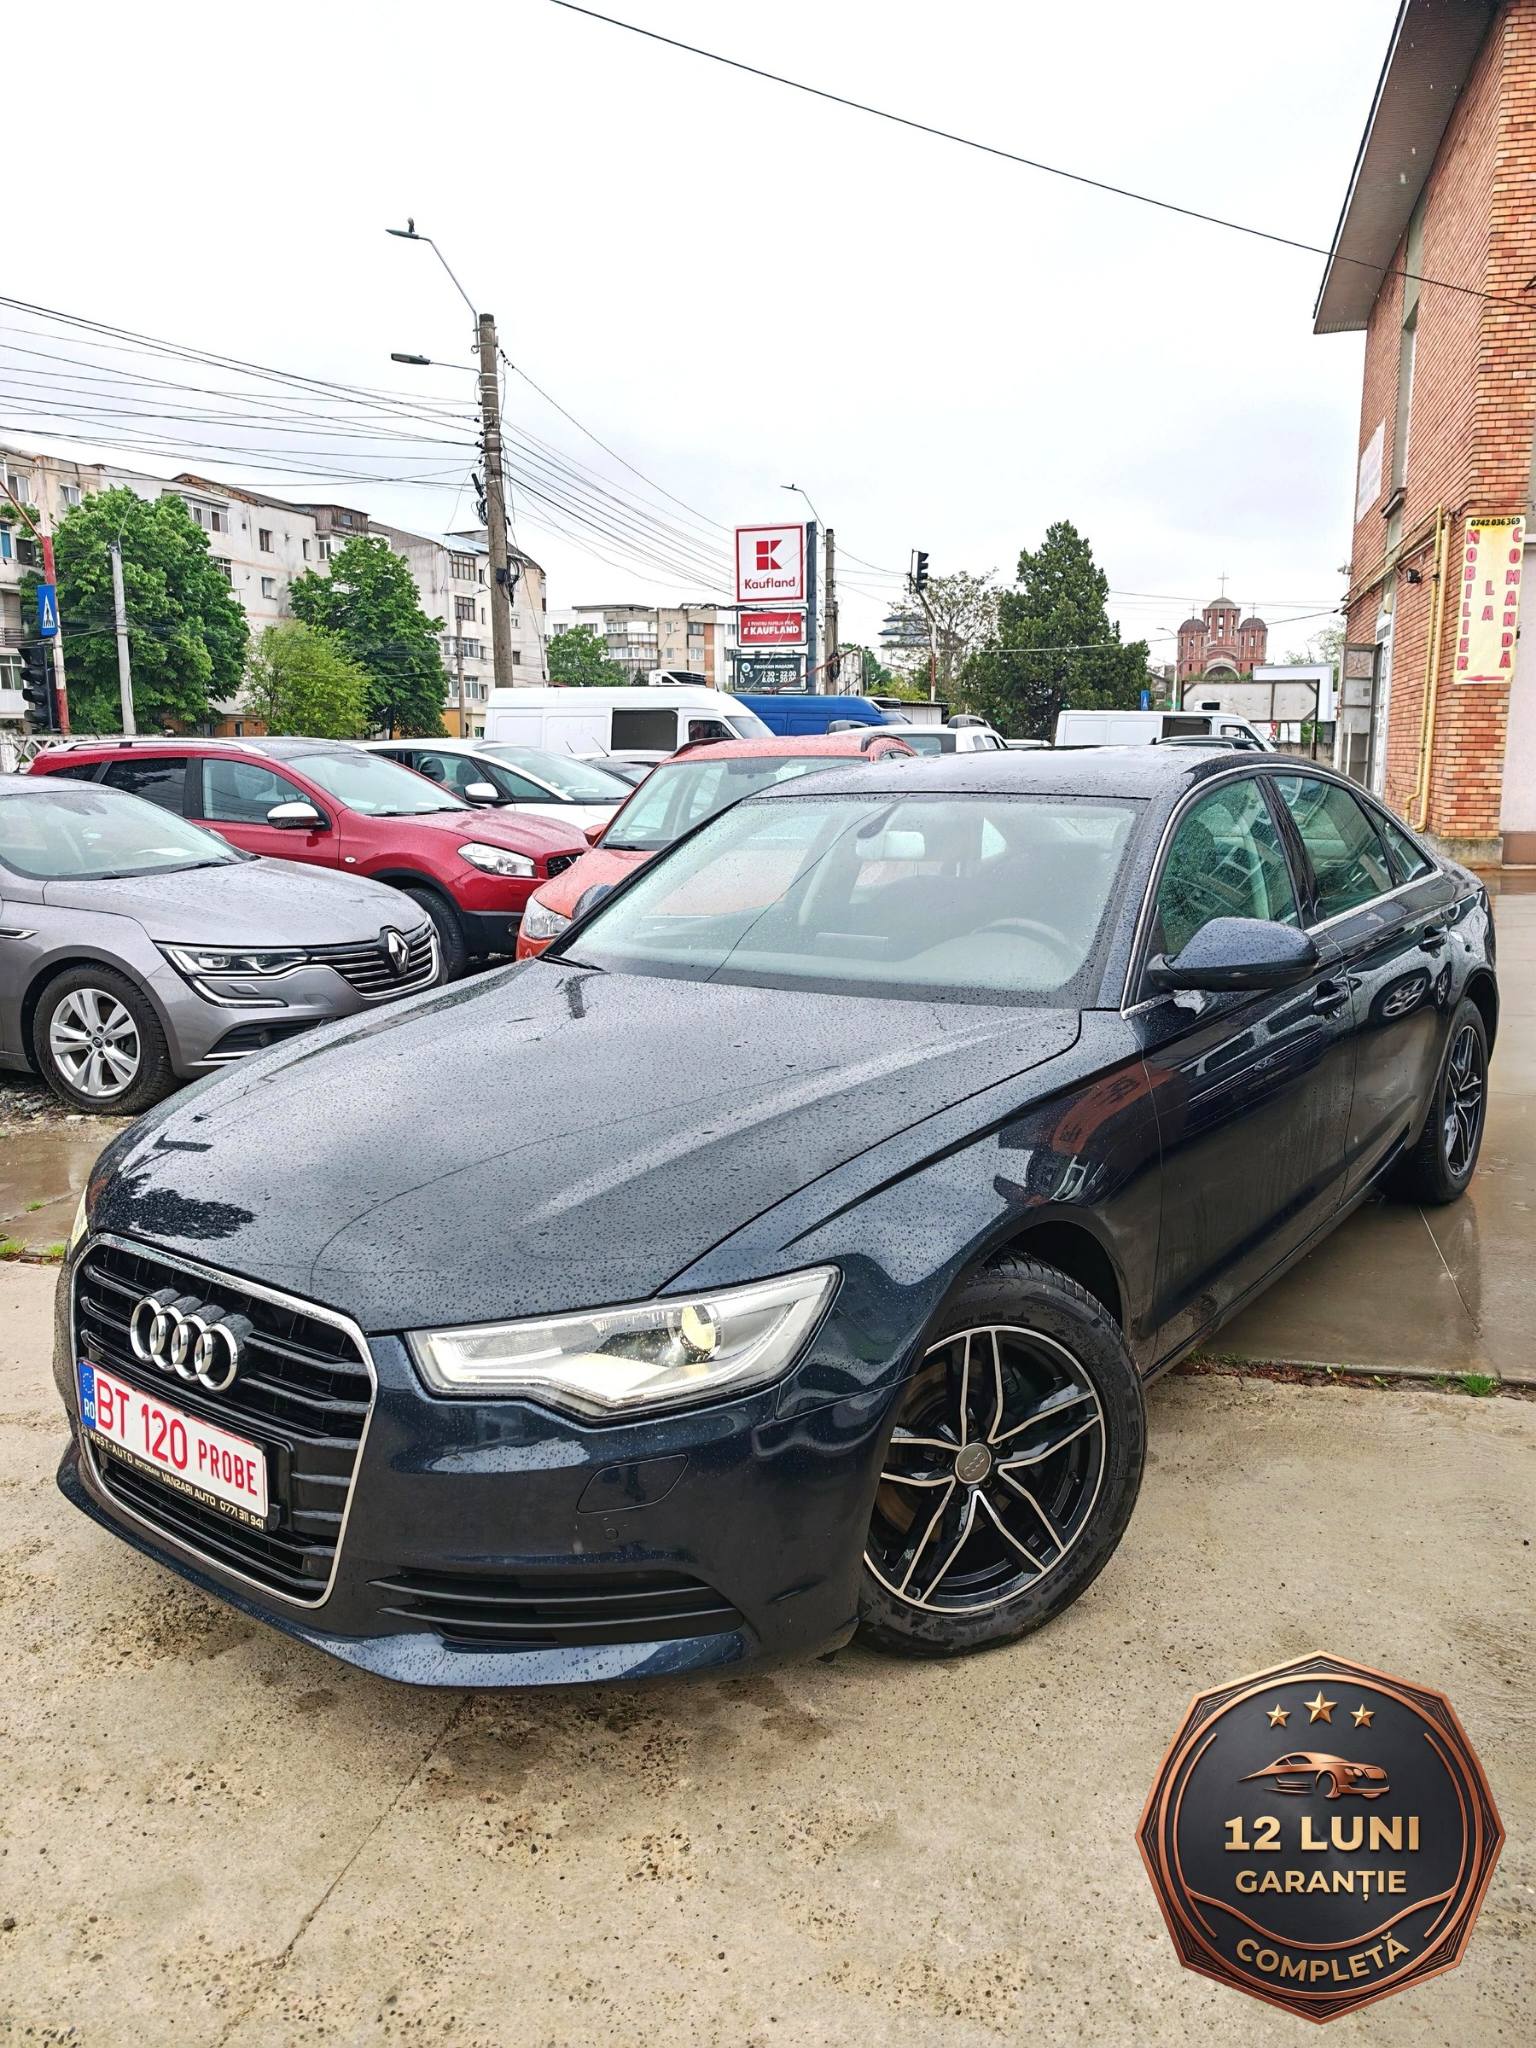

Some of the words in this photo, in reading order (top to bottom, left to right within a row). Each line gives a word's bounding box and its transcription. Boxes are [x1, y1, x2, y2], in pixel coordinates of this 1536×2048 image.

[1470, 518, 1490, 526] 0742
[1491, 518, 1505, 526] 036
[1506, 517, 1521, 525] 369
[744, 577, 796, 590] Kaufland
[1456, 529, 1480, 670] MOBILIER
[1481, 580, 1496, 621] LA
[750, 626, 799, 635] KAUFLAND
[84, 1399, 95, 1420] RO
[96, 1378, 130, 1439] BT
[140, 1403, 188, 1470] 120
[198, 1438, 258, 1496] PROBE
[161, 1471, 194, 1496] VANZARI
[194, 1489, 216, 1506] AUTO
[250, 1515, 264, 1530] 941
